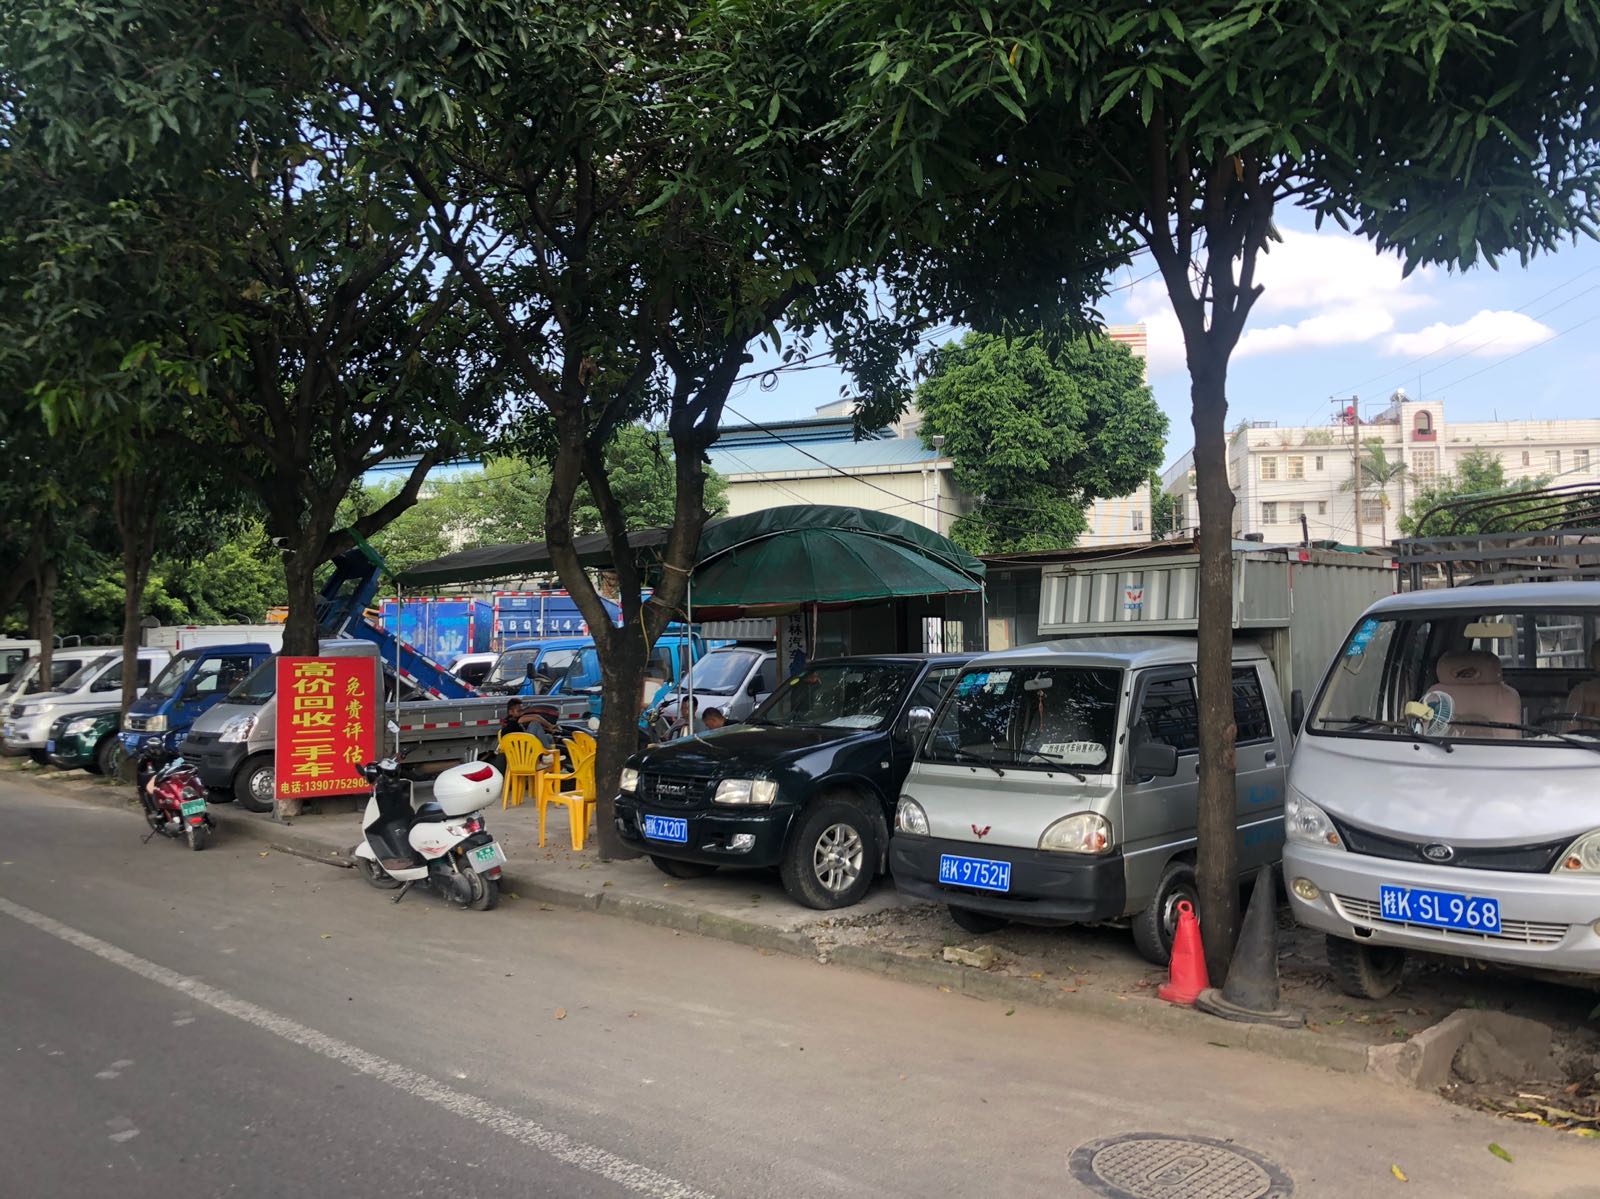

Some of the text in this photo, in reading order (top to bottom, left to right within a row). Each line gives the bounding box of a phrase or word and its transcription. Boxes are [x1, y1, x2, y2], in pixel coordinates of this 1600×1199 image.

[291, 661, 336, 777] 高价回收二手车
[342, 676, 365, 764] 免费评估
